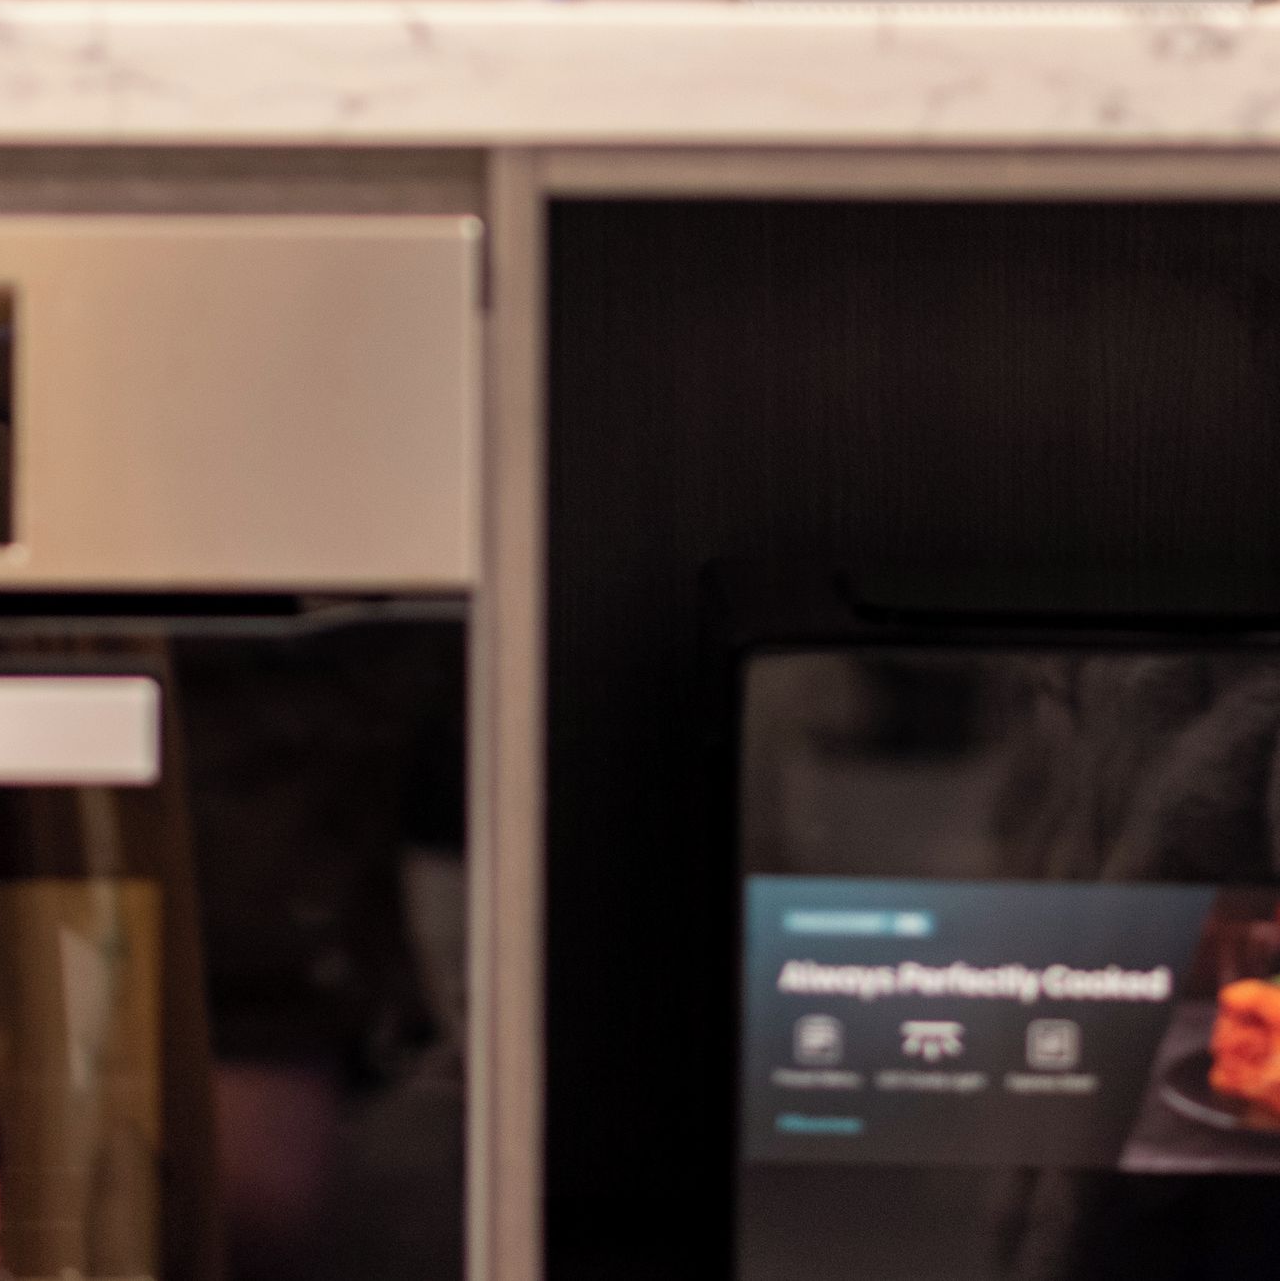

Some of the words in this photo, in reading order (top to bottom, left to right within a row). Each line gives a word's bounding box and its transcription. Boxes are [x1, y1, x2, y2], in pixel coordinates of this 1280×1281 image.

[778, 960, 894, 1000] Always
[896, 961, 1040, 1004] Perfectly
[1042, 963, 1172, 1000] Cooked
